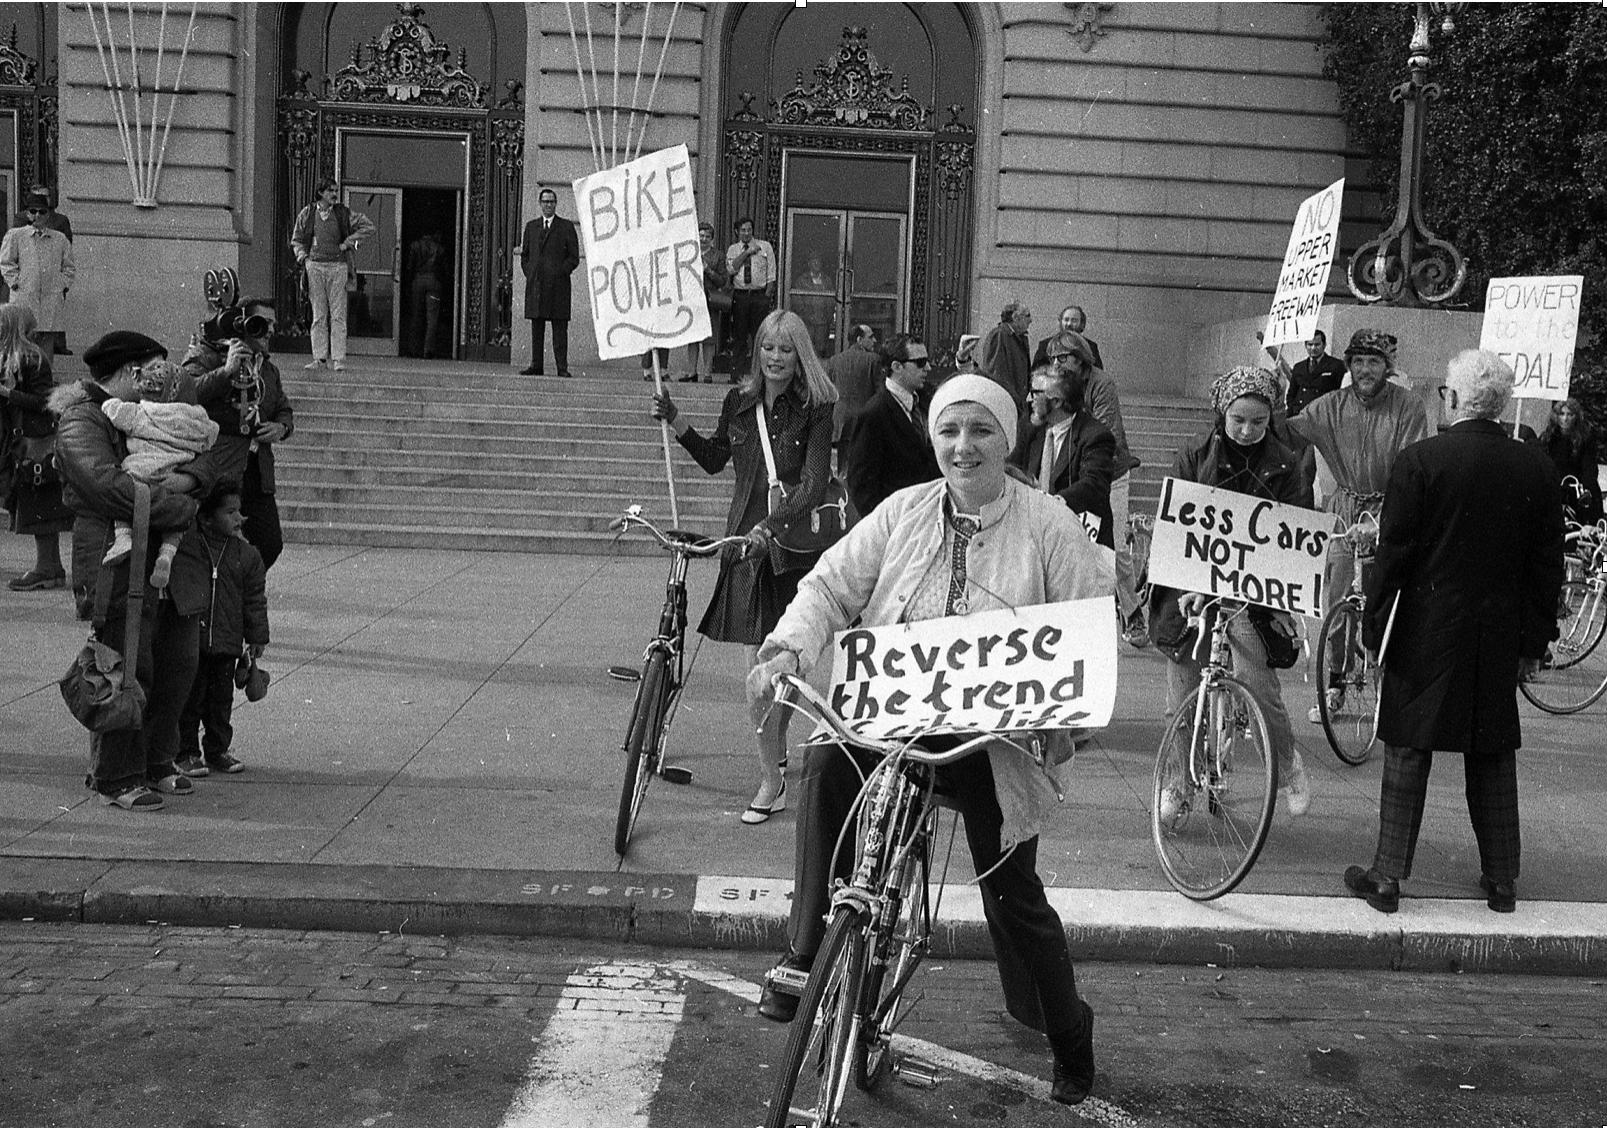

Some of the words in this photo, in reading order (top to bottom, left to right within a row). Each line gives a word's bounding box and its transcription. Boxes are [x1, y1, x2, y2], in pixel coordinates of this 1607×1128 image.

[1301, 190, 1334, 236] NO
[1287, 233, 1332, 267] UPPER
[591, 240, 704, 320] POWER
[1279, 261, 1329, 293] MARKET
[1271, 294, 1323, 323] FREEWAY
[1488, 284, 1578, 310] POWER
[1494, 313, 1519, 339] to
[1537, 318, 1576, 339] the
[1160, 479, 1233, 535] Less
[1248, 501, 1328, 557] Cars
[1184, 531, 1256, 571] NOT
[840, 625, 1062, 682] Reverse
[831, 681, 911, 721] the
[922, 659, 1084, 713] trend
[720, 888, 770, 901] SF
